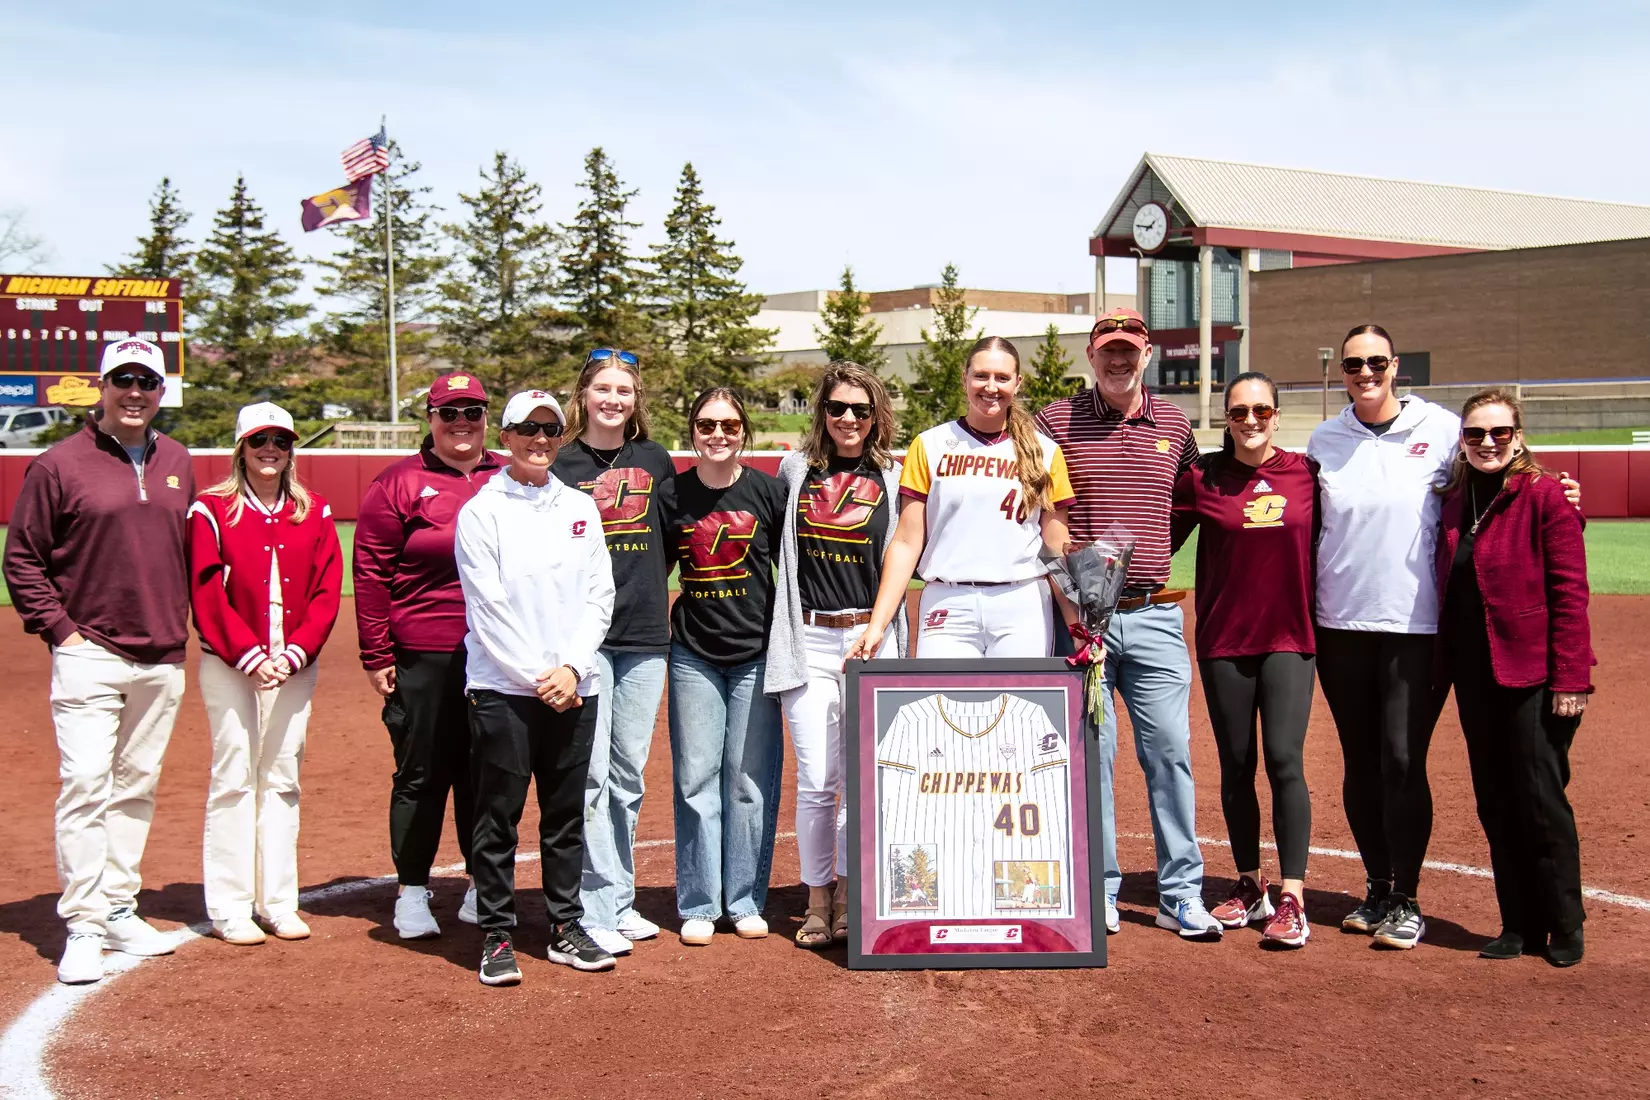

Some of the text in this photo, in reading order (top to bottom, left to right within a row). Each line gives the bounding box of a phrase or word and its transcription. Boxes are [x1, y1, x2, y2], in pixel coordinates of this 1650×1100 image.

[5, 276, 90, 295] MICHIGAN
[92, 279, 170, 297] SOFTBALL
[16, 297, 57, 310] STRIKE
[78, 299, 104, 311] OUT
[40, 329, 49, 340] 7
[69, 329, 77, 340] 9
[936, 454, 1019, 481] CHIPPEWA
[607, 542, 649, 552] FTBALL
[920, 772, 1023, 794] CHIPPEWAS
[993, 803, 1041, 837] 40
